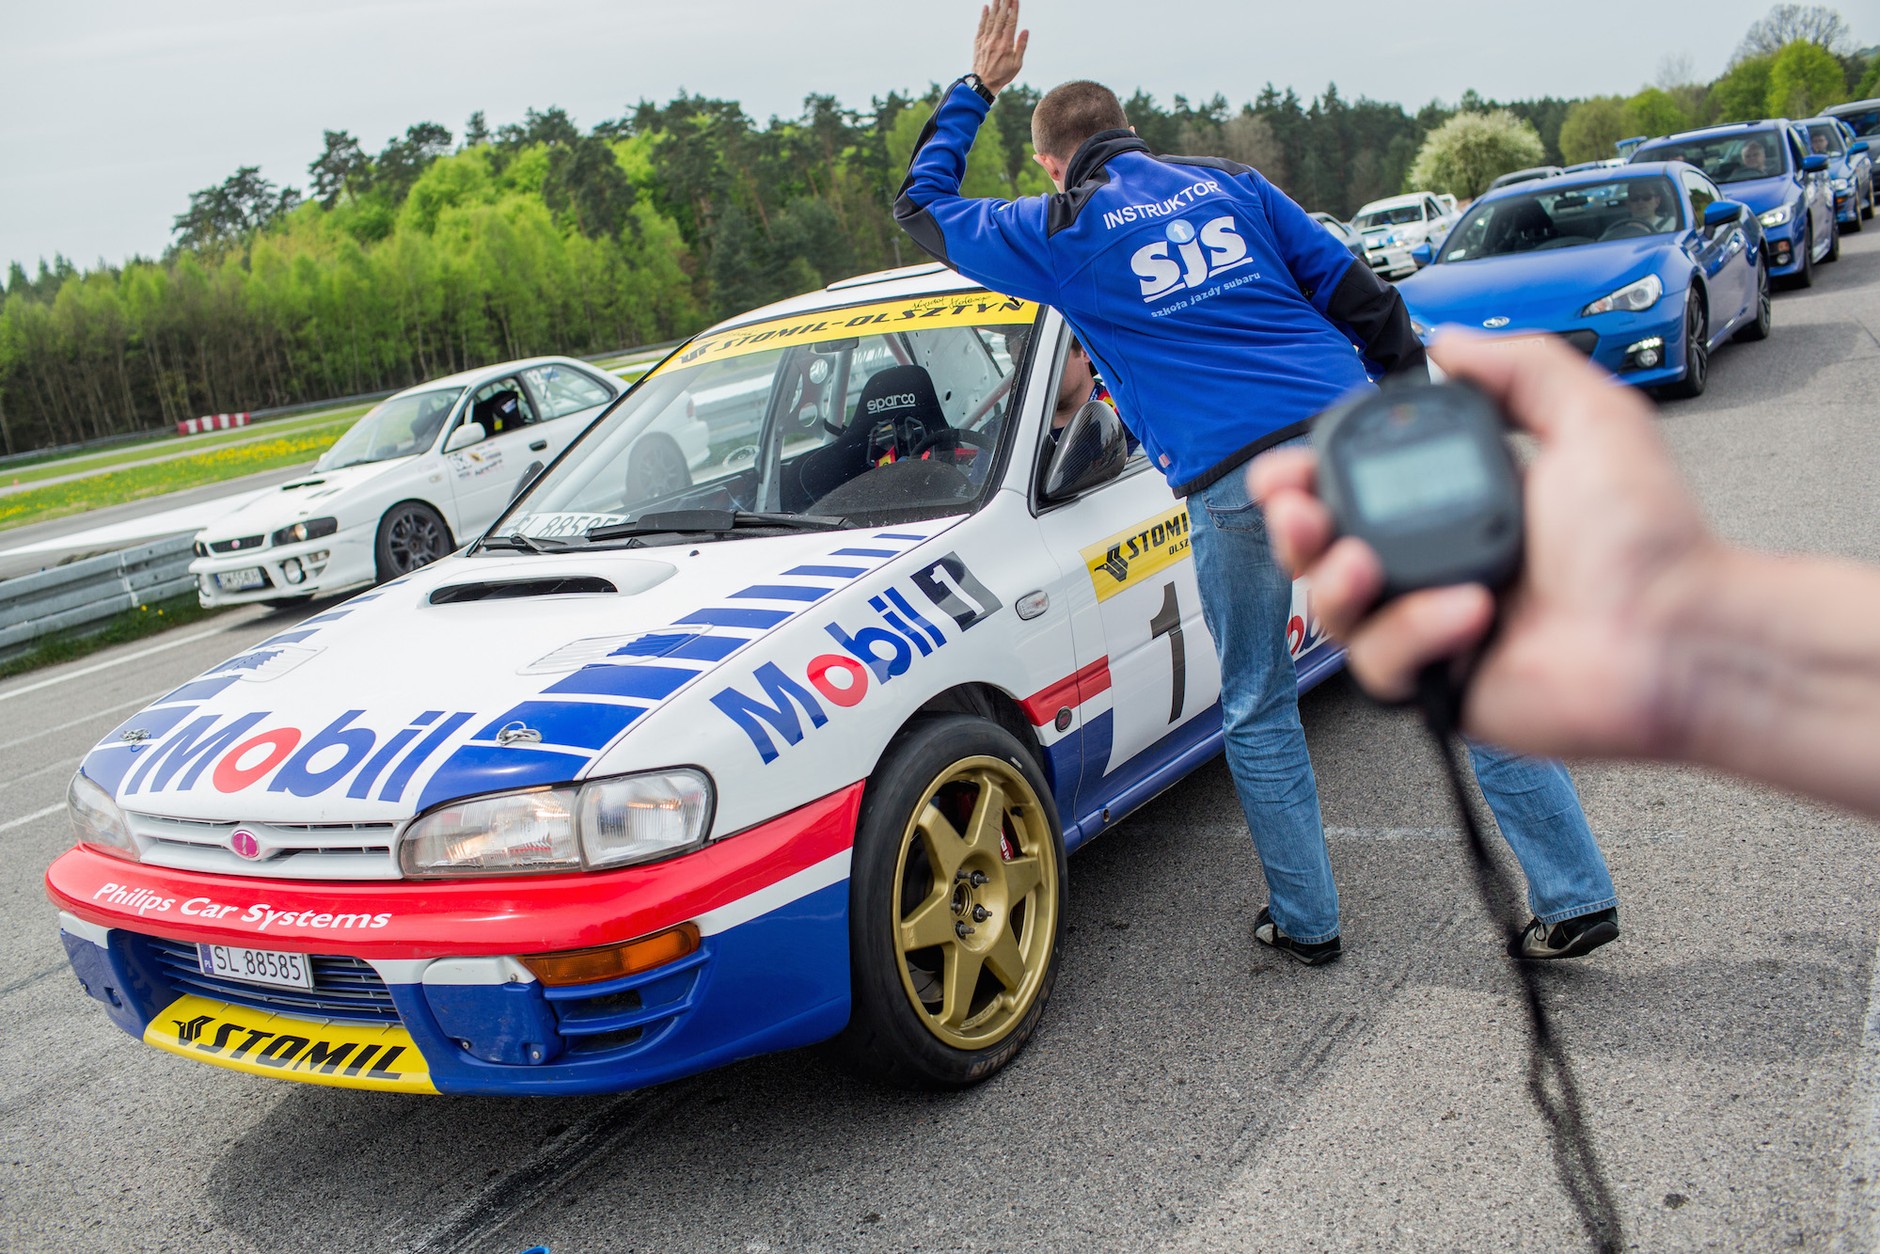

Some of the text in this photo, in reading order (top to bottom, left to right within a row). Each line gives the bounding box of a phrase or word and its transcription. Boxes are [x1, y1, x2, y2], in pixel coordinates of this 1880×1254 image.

[1103, 181, 1222, 229] INSTRUKTOR
[1190, 285, 1220, 305] jazdy
[1223, 272, 1261, 290] subaru
[714, 302, 1025, 352] STOMIL-OLSZTYN
[867, 393, 916, 413] sparco
[1127, 512, 1189, 560] STOMI
[1169, 538, 1189, 555] OLSZ
[709, 587, 947, 765] Mobil
[1150, 581, 1186, 725] 1
[124, 710, 477, 803] Mobil
[93, 882, 392, 931] Philips Car Systems
[214, 946, 301, 980] SL 88585
[197, 1023, 407, 1080] STOMIL
